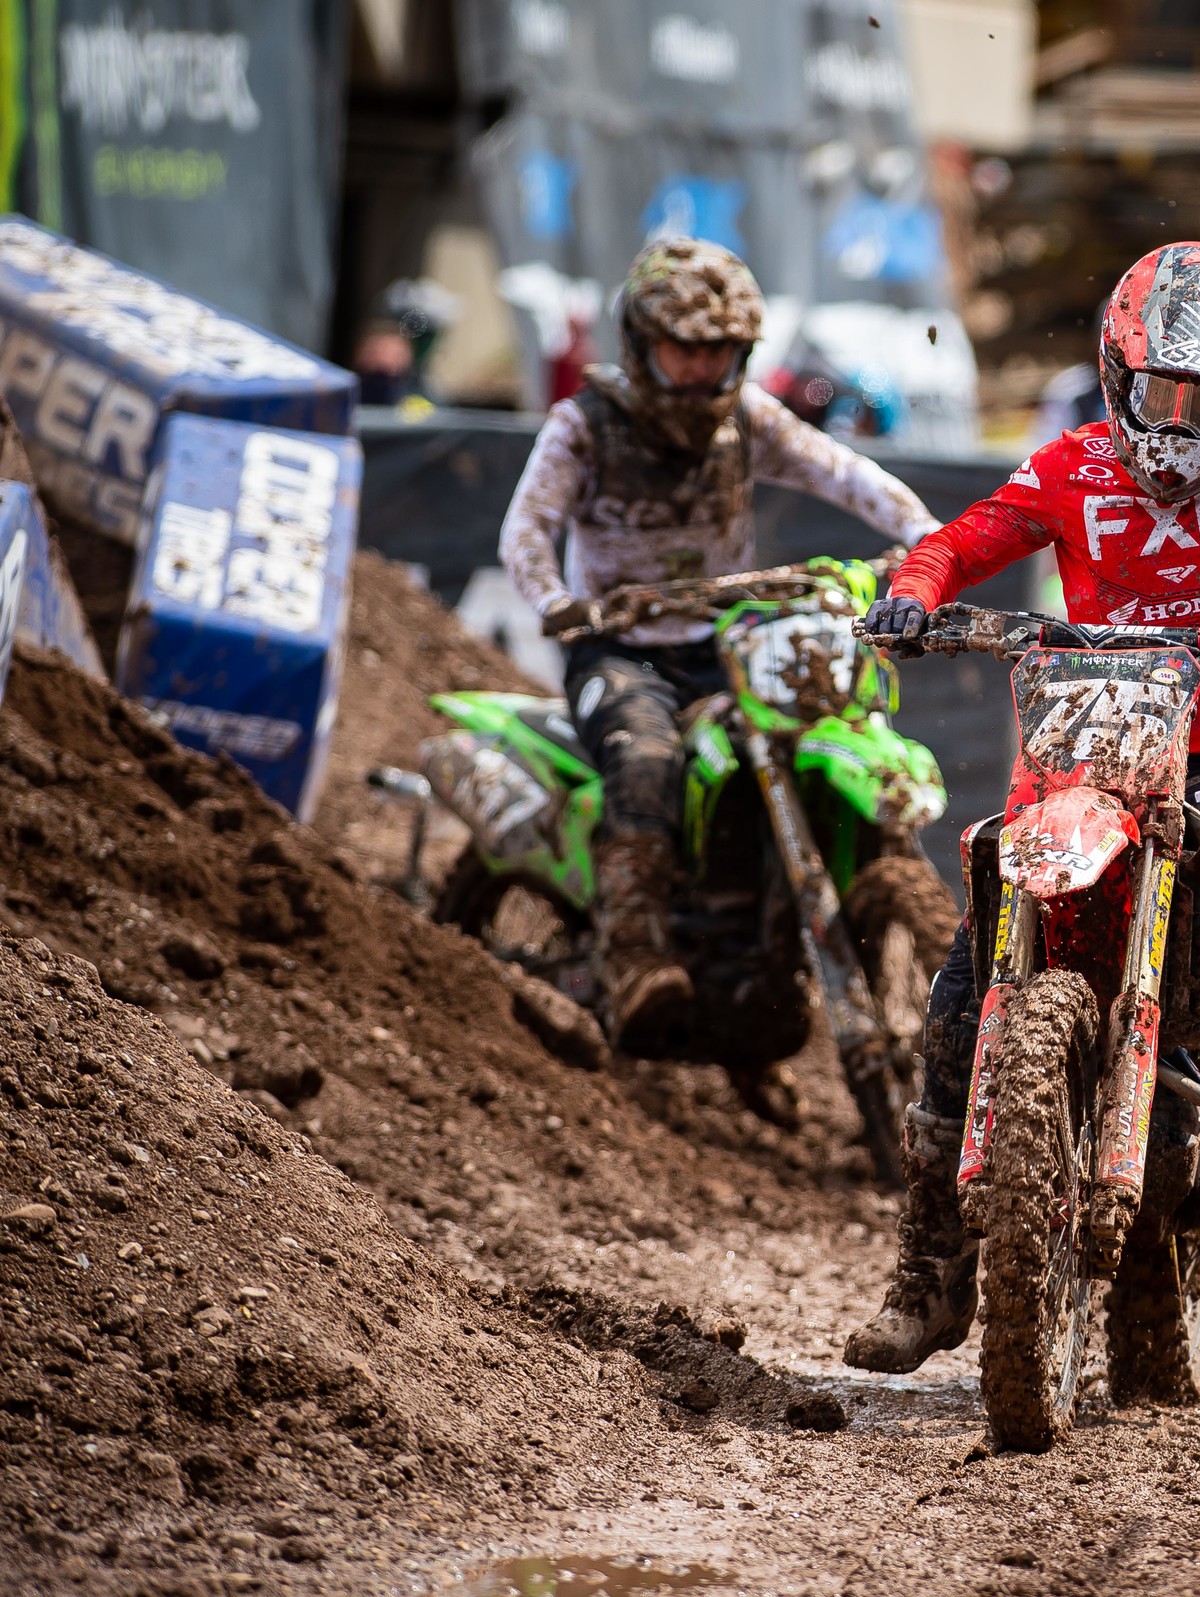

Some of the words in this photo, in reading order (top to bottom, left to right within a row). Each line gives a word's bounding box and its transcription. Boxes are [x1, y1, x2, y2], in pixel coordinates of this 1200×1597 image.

[1083, 453, 1116, 465] HELMETS
[1069, 473, 1120, 486] OAKLEY
[1082, 655, 1144, 667] MONSTER
